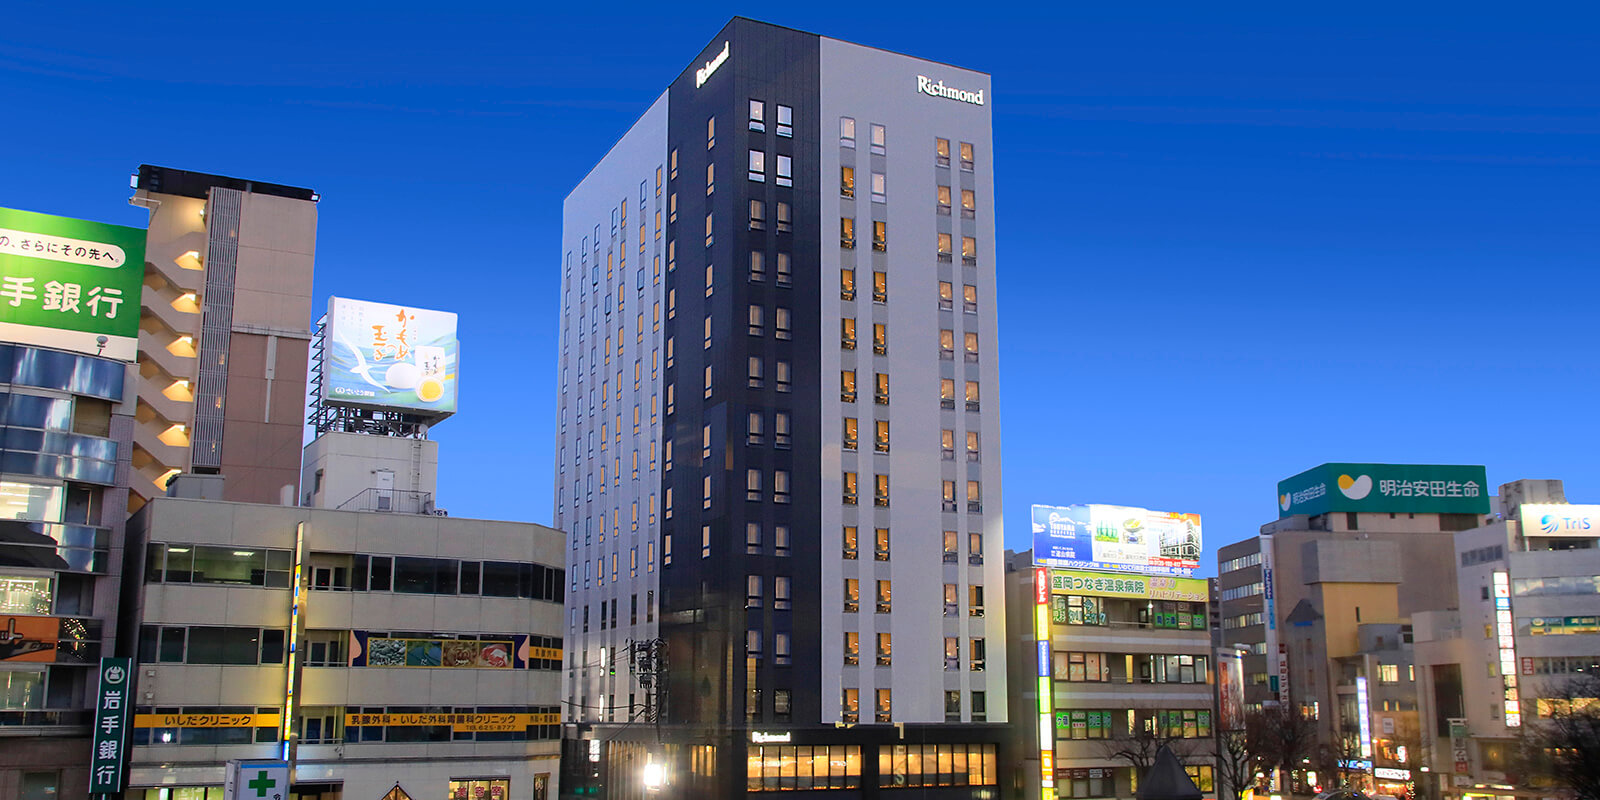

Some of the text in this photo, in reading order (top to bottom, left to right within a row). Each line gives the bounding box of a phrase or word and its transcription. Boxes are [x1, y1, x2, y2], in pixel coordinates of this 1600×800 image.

[696, 41, 730, 88] Richmond
[917, 75, 984, 105] Richmond
[0, 276, 123, 319] 手銀行
[1292, 482, 1326, 505] 明治安田生命
[1379, 480, 1479, 497] 明治安田生命
[1562, 517, 1591, 530] TriS
[1052, 576, 1144, 594] 盛岡つなぎ温泉病院
[1149, 590, 1207, 601] リハビリテーション
[165, 715, 251, 726] いしだクリニック
[97, 691, 121, 785] 岩手銀行
[455, 786, 502, 798] 美容室
